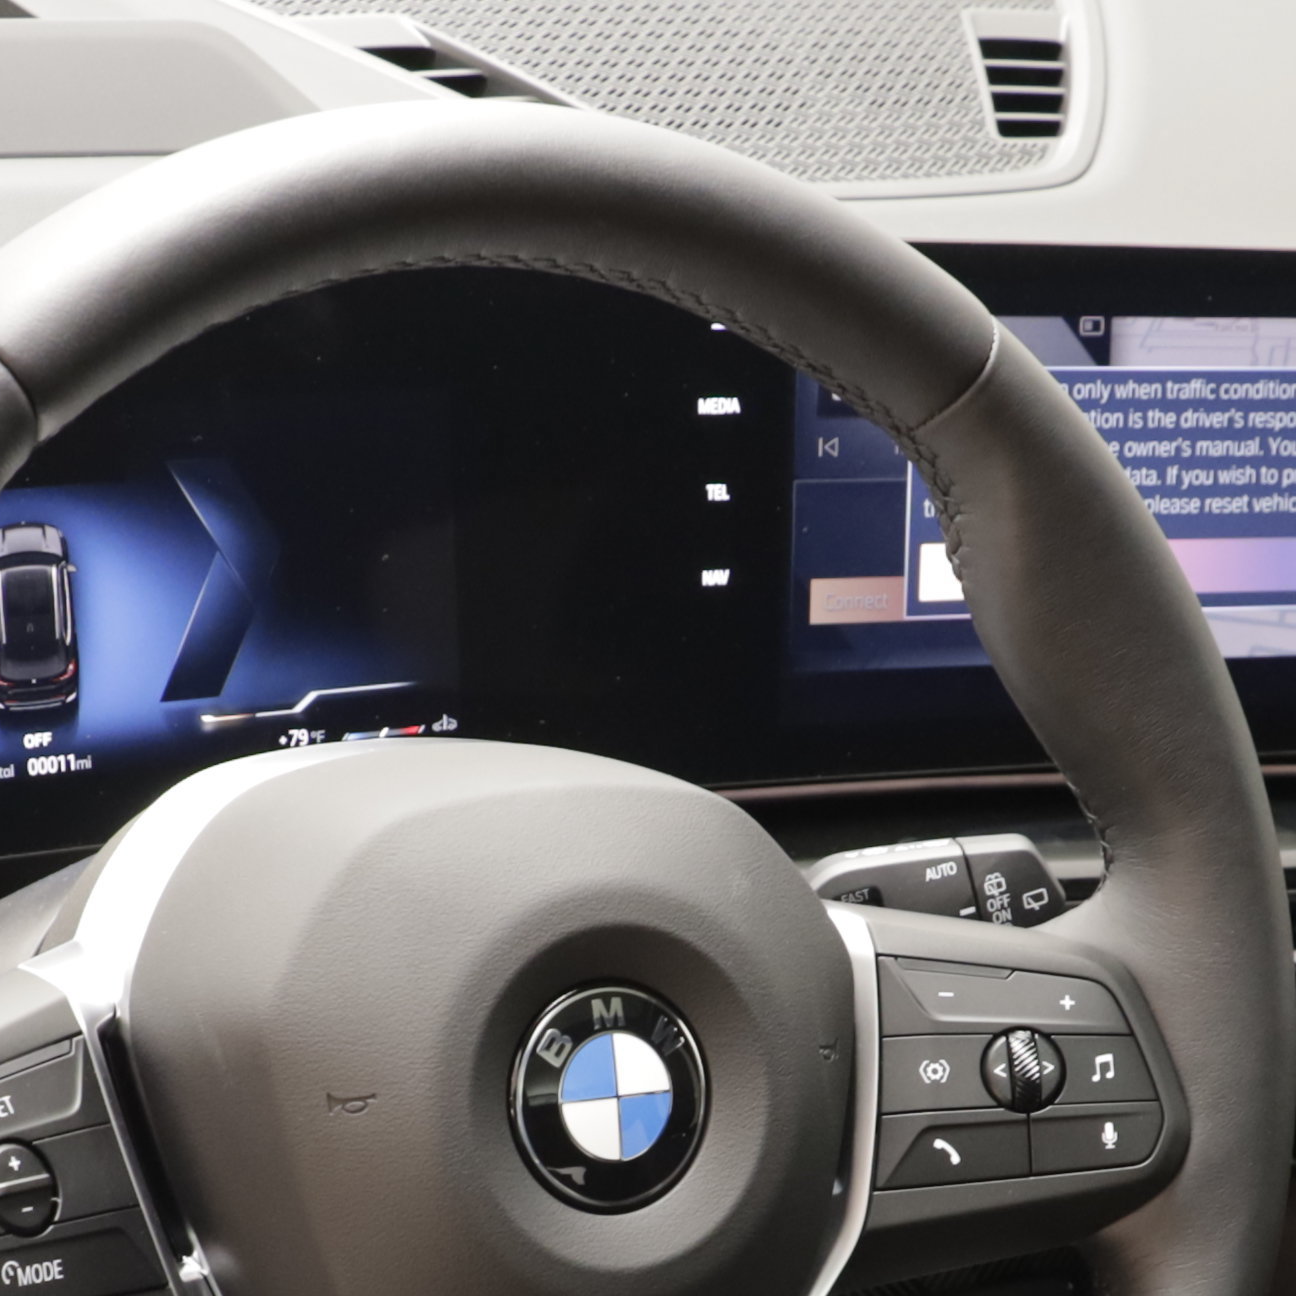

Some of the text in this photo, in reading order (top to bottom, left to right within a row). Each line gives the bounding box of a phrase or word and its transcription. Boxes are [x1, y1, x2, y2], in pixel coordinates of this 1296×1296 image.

[1072, 379, 1110, 404] only
[1114, 379, 1161, 400] when
[1166, 378, 1216, 400] traffic
[697, 397, 741, 415] MEDIA
[1129, 408, 1143, 429] is
[1147, 409, 1176, 429] the
[1180, 408, 1245, 429] driver's
[1123, 437, 1192, 458] owner's
[1196, 436, 1264, 457] manual.
[1166, 464, 1180, 485] If
[1181, 468, 1214, 490] you
[1218, 465, 1256, 485] wish
[1260, 466, 1278, 485] to
[706, 483, 730, 501] TEL
[1146, 494, 1200, 515] please
[1204, 494, 1249, 513] reset
[702, 569, 731, 586] NAV
[23, 732, 52, 749] OFF
[925, 861, 957, 882] AUTO
[986, 893, 1011, 912] OFF
[992, 908, 1012, 924] ON
[17, 1259, 64, 1287] MODE
